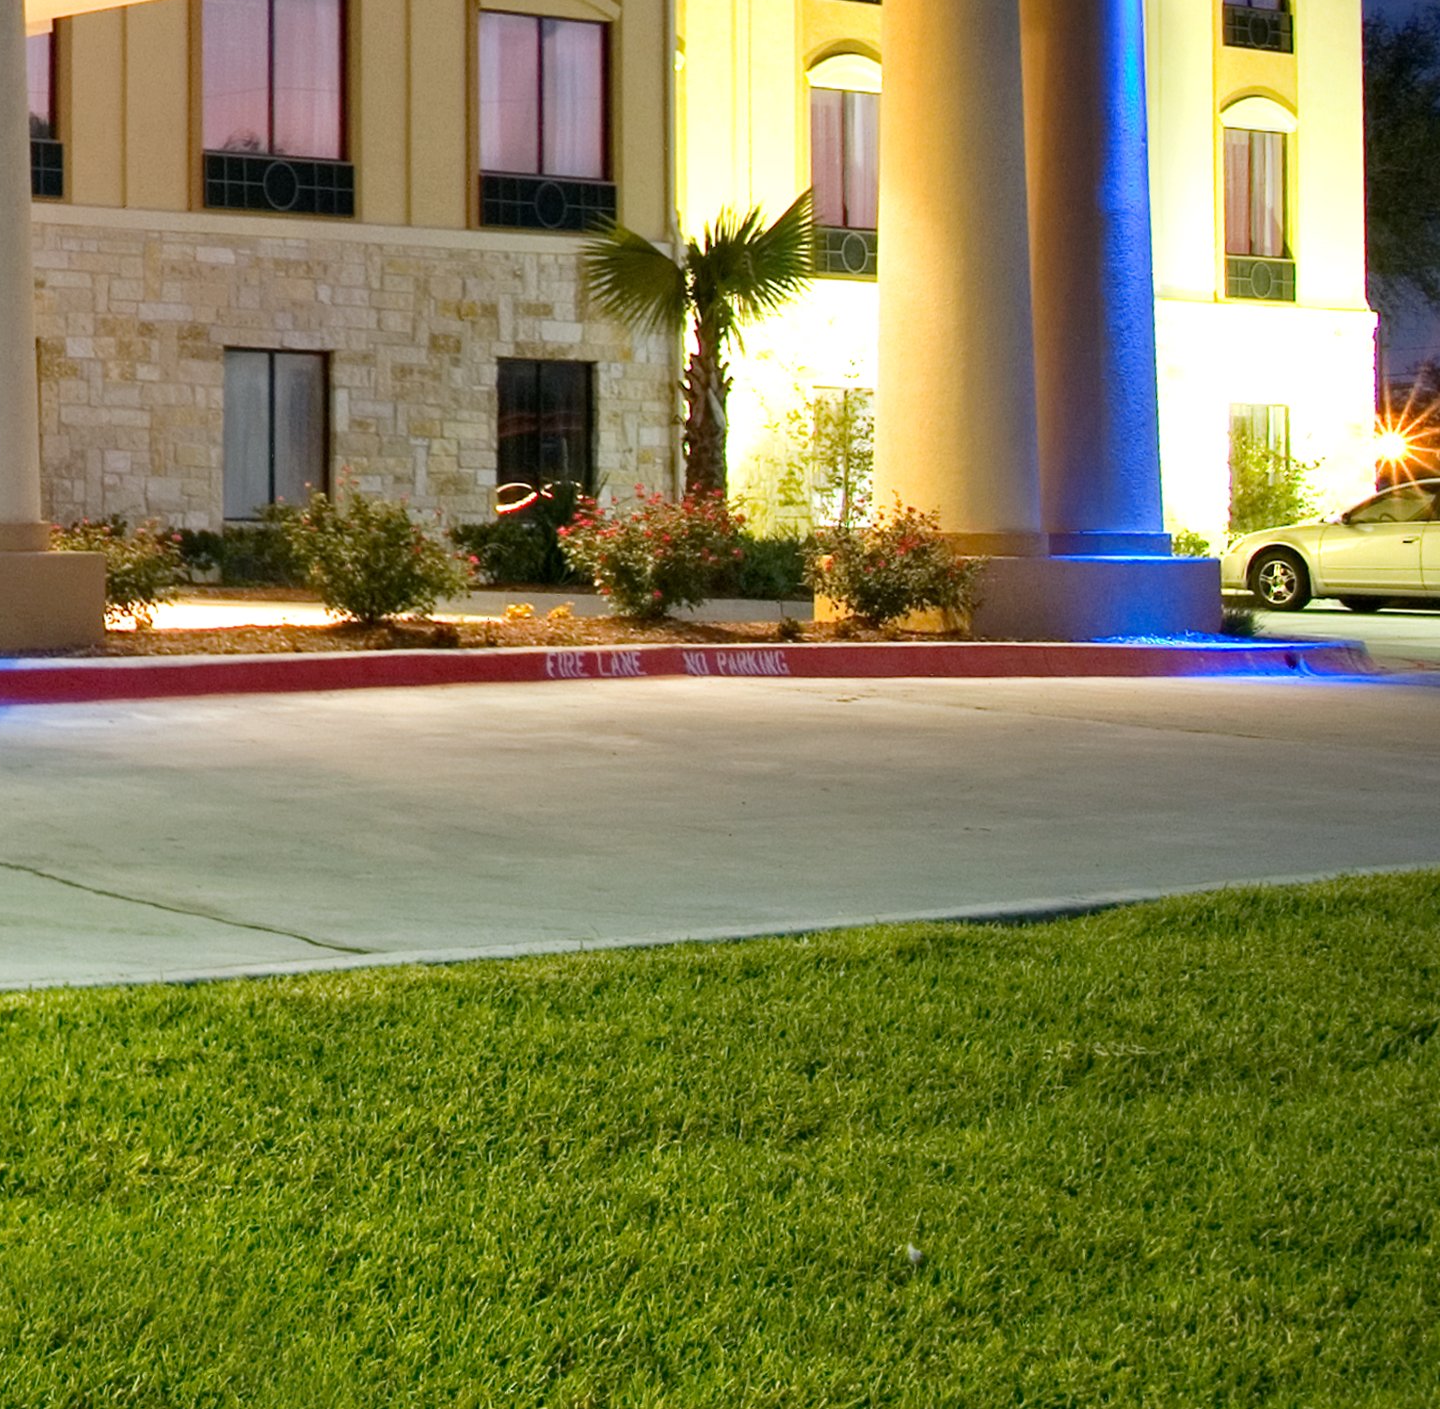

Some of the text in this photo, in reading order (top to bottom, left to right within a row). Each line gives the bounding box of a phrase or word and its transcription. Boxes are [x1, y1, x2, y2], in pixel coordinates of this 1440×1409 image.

[546, 649, 792, 678] FIRE LANE NO PARKING
